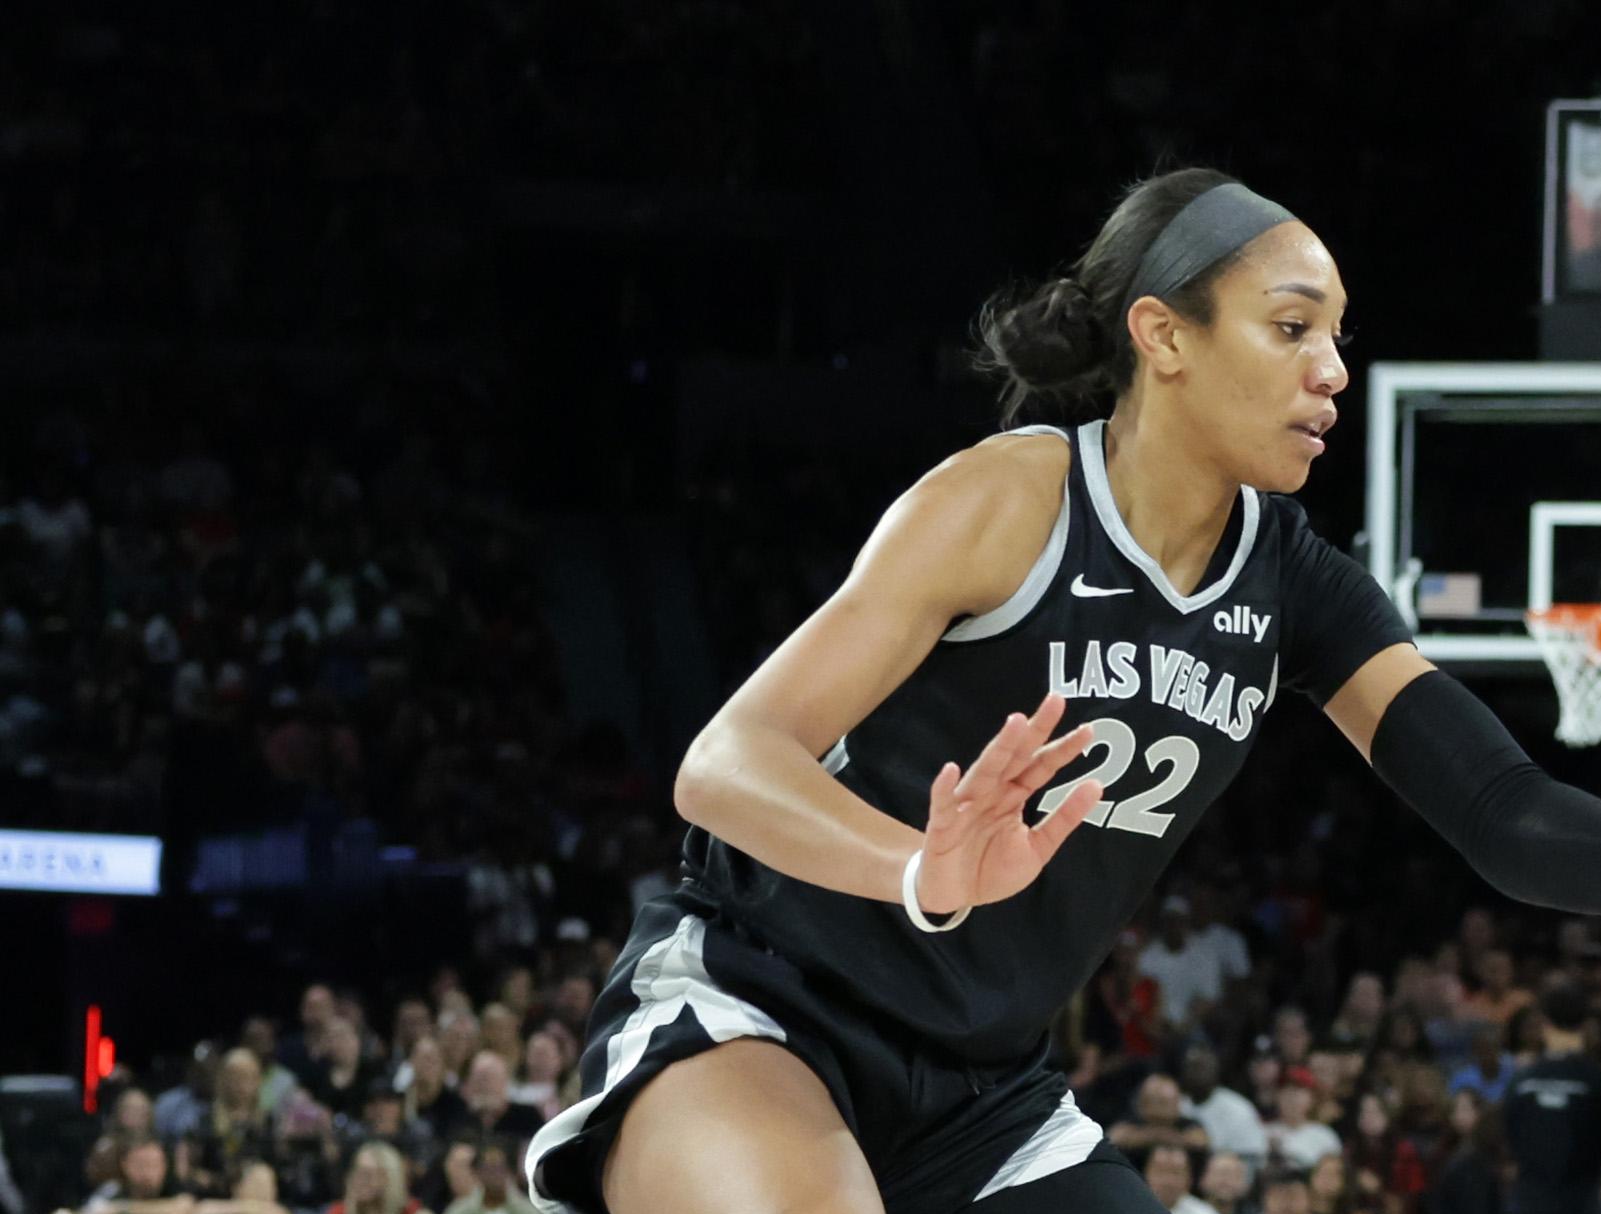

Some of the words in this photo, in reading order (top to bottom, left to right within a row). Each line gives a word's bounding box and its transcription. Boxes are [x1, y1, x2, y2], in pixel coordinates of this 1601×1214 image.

[1213, 605, 1272, 643] ally
[1049, 640, 1141, 699] LAS
[1149, 644, 1265, 742] VEGAS
[1036, 717, 1200, 838] 22
